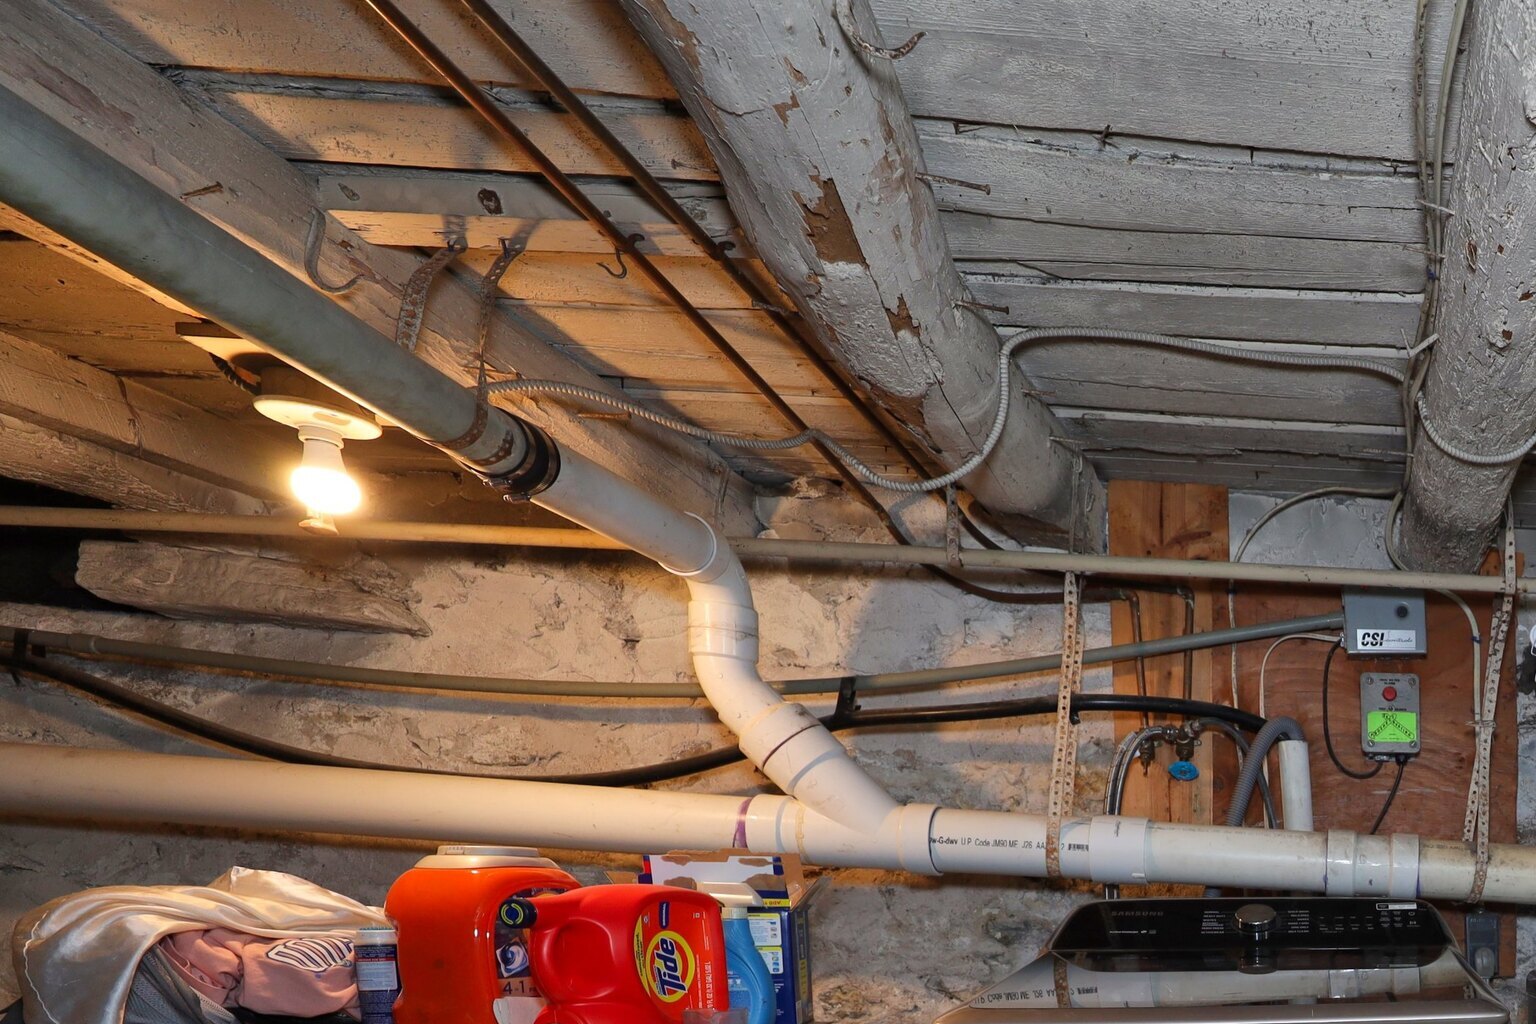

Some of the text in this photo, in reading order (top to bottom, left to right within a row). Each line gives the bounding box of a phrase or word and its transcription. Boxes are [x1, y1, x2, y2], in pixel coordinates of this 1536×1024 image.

[1361, 632, 1385, 646] CSI
[975, 838, 990, 847] Code
[654, 937, 687, 997] Tide
